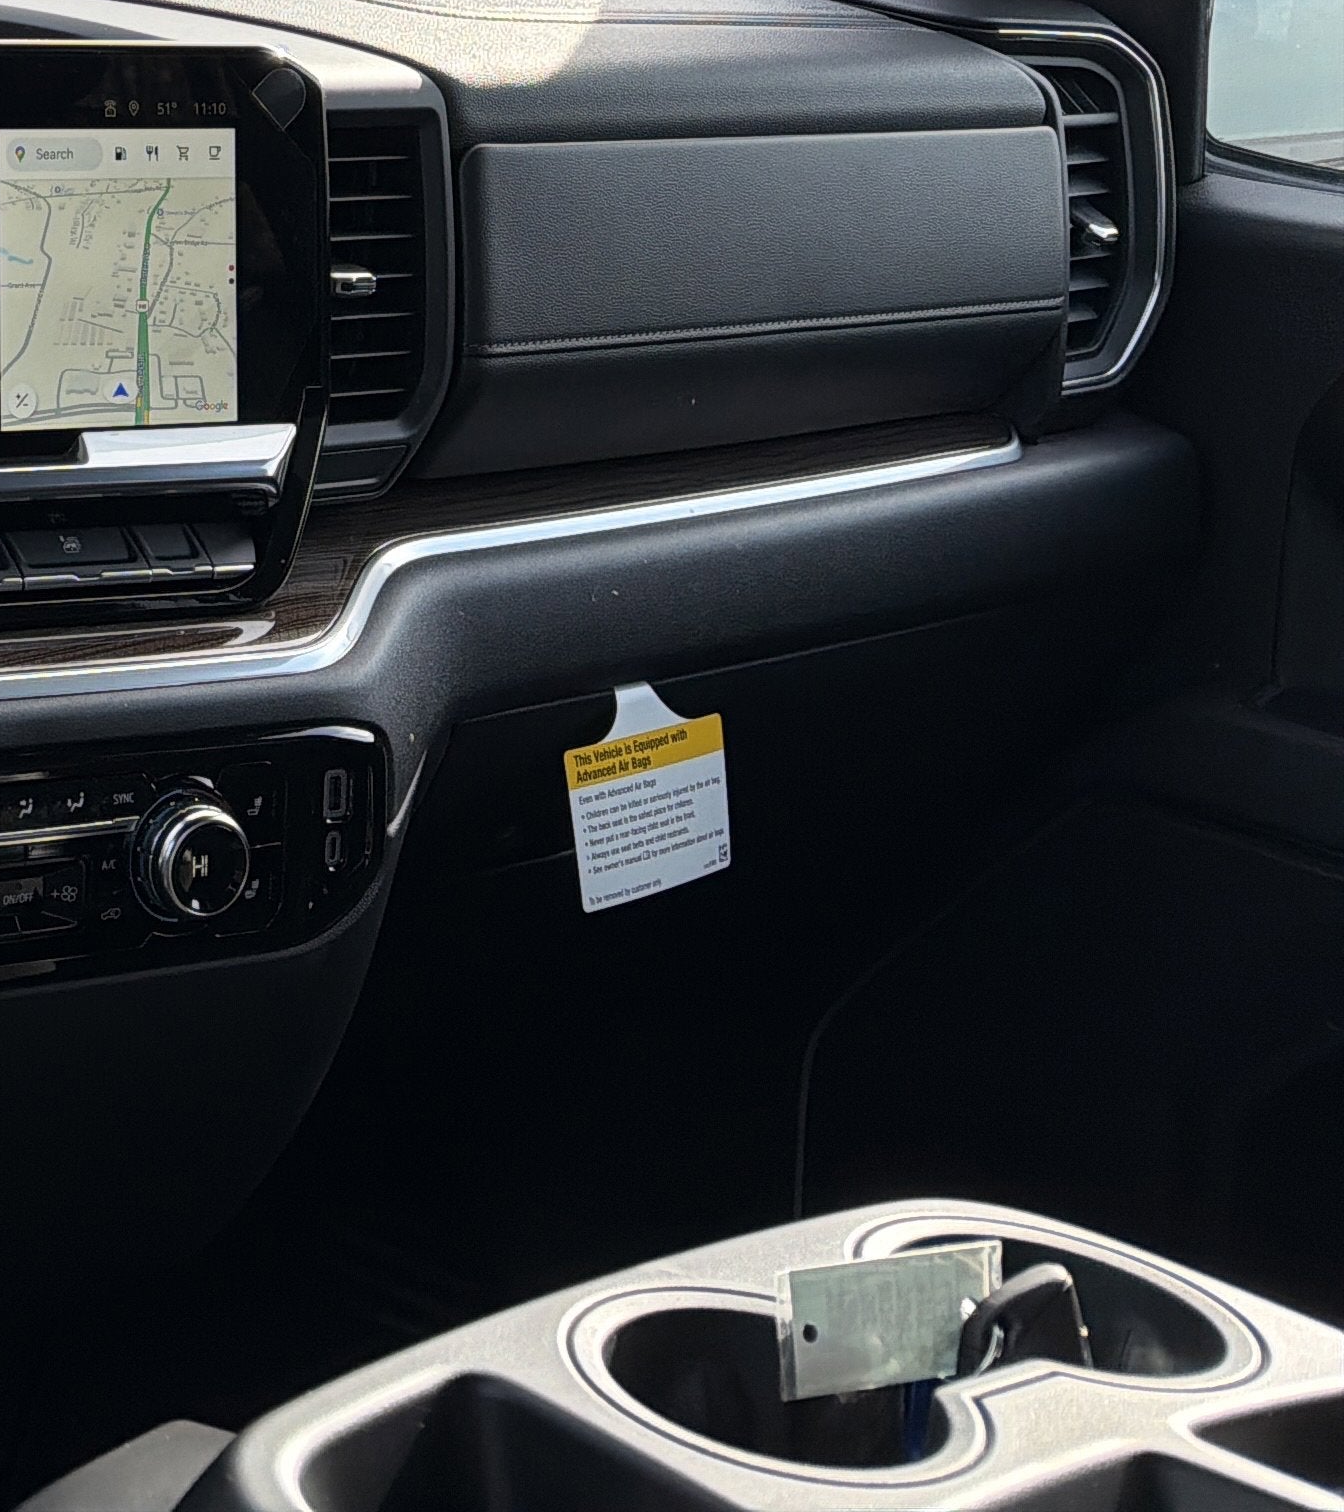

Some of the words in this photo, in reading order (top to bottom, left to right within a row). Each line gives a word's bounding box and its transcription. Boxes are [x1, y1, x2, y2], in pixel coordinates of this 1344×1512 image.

[157, 102, 178, 115] 51°
[193, 102, 226, 115] 11:10
[36, 148, 74, 161] Search
[195, 399, 228, 413] Google
[573, 753, 592, 767] This
[593, 746, 623, 762] Vehicle
[624, 743, 632, 755] is
[633, 732, 669, 754] Equipped
[671, 729, 687, 743] with
[577, 761, 617, 783] Advanced
[619, 758, 630, 772] Air
[632, 755, 652, 771] Bags
[579, 795, 593, 805] Even
[594, 791, 606, 801] with
[608, 784, 633, 798] Advanced
[643, 778, 656, 790] Bags
[113, 793, 134, 804] SYNC
[102, 860, 117, 871] A/C
[190, 854, 209, 879] HI
[3, 893, 34, 906] ON/OFF
